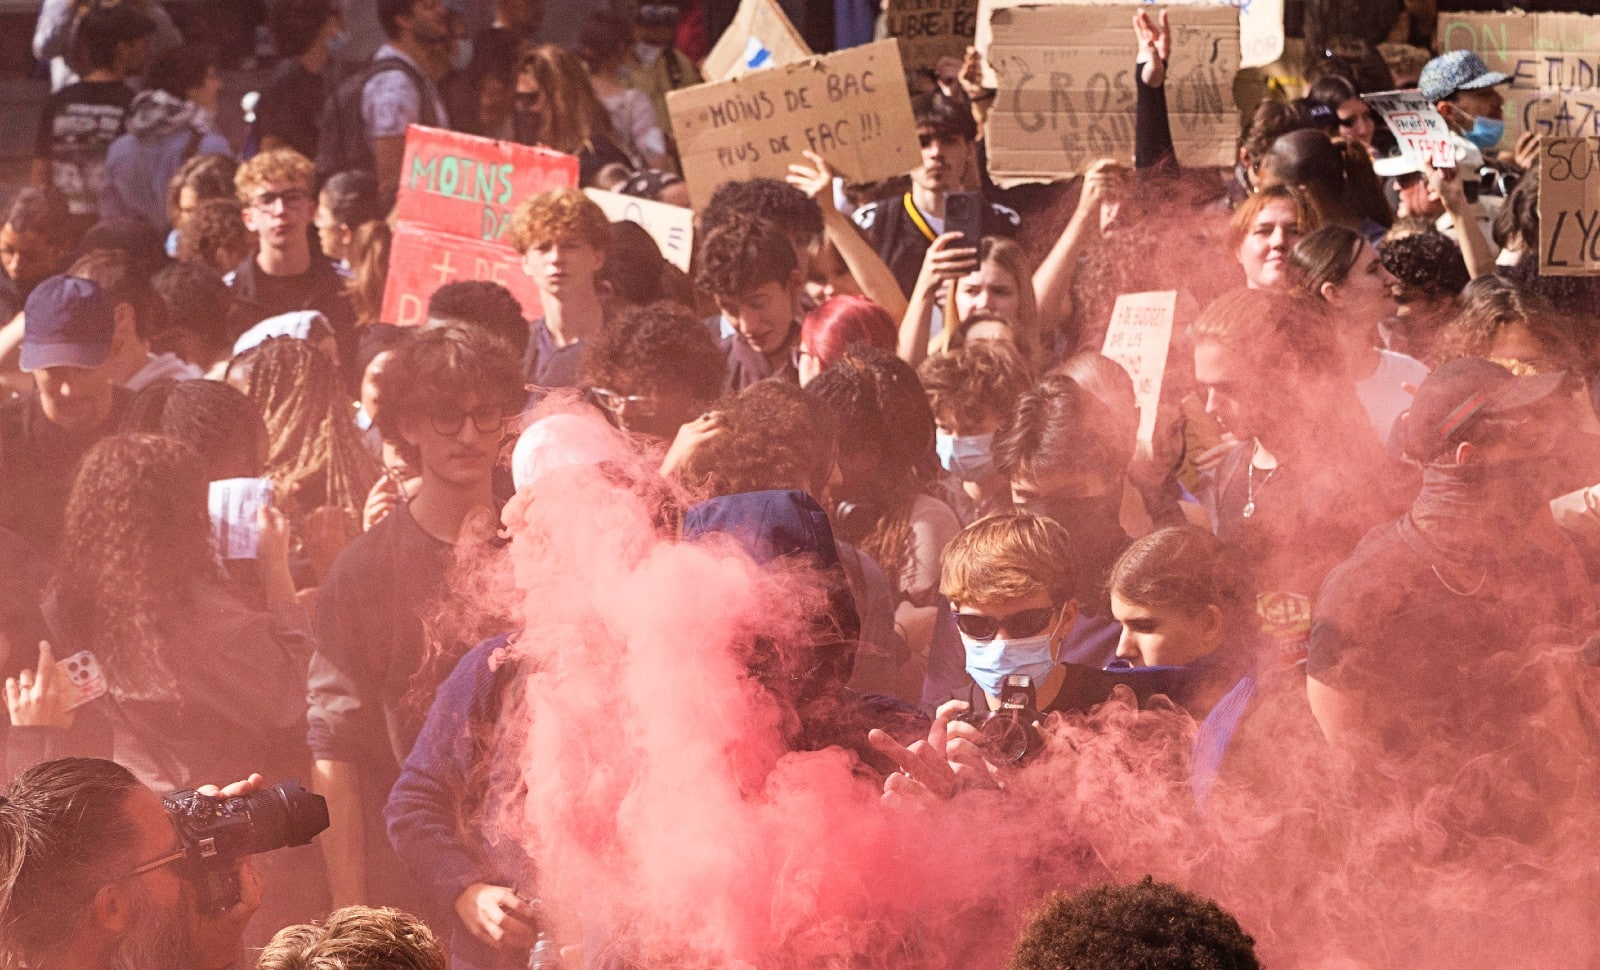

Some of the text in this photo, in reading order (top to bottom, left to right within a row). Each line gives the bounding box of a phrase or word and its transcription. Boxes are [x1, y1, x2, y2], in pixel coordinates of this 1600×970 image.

[784, 87, 812, 112] DE
[827, 71, 876, 102] BAC
[768, 136, 792, 154] DE
[804, 119, 849, 152] FAC
[409, 153, 514, 205] MOINS
